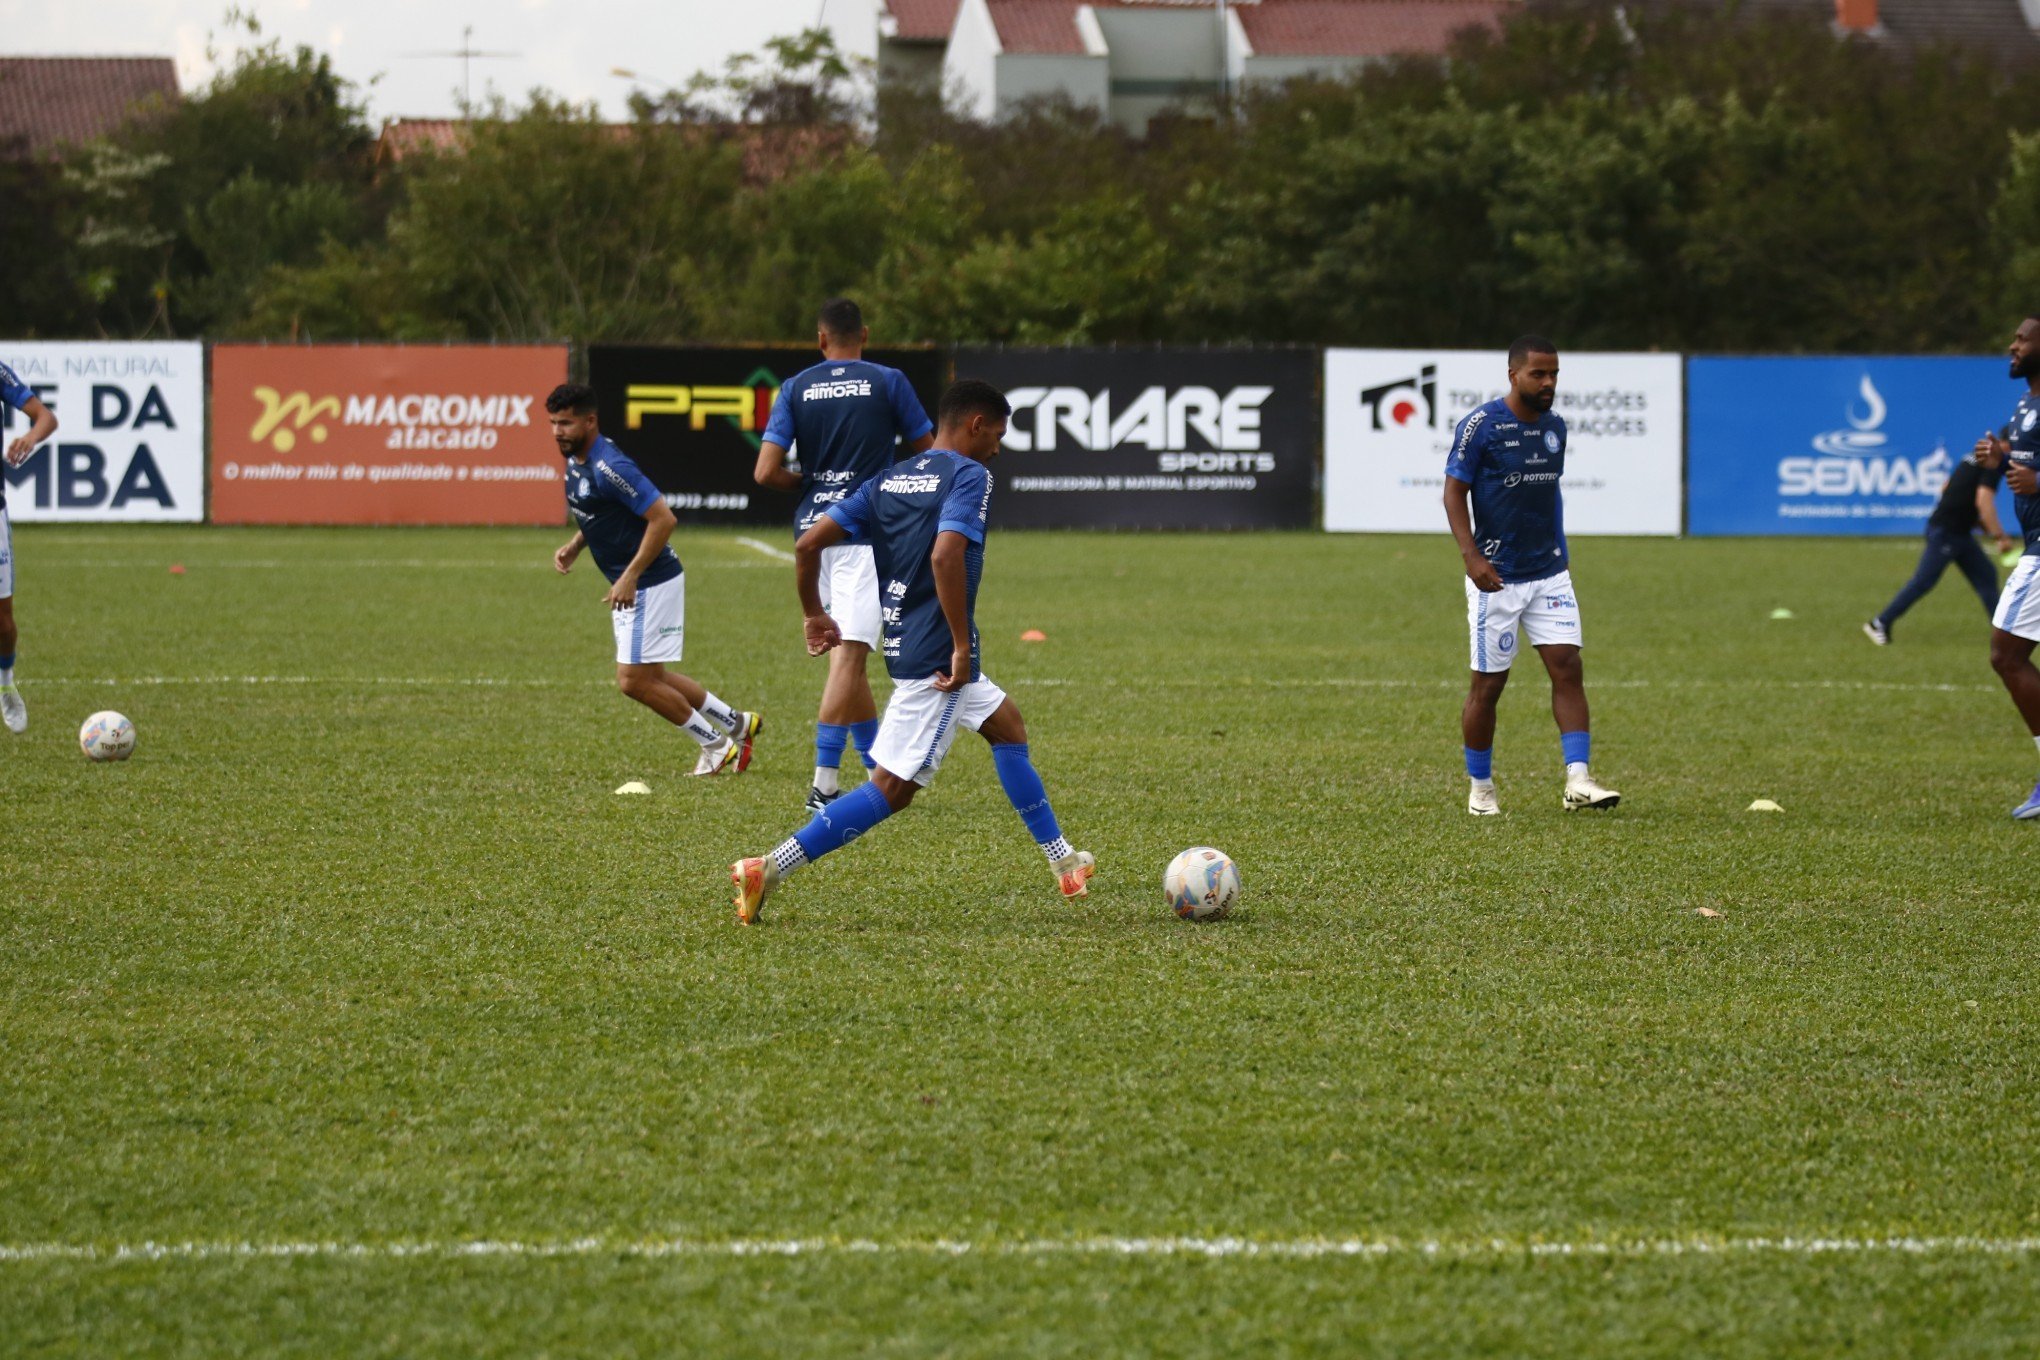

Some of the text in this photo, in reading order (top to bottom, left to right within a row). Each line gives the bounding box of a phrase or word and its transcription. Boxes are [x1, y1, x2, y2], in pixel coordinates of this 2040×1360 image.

[65, 357, 177, 377] NATURAL
[803, 380, 872, 401] AIMORÉ
[91, 384, 177, 430] DA
[344, 394, 534, 426] MACROMIX
[1000, 386, 1274, 450] CRIARE
[386, 427, 498, 449] atacado
[1459, 411, 1487, 452] VINCITORE
[223, 462, 239, 480] O
[243, 461, 303, 480] melhor
[306, 462, 338, 480] mix
[342, 461, 364, 480] de
[368, 461, 453, 485] qualidade
[456, 465, 468, 480] e
[472, 461, 559, 480] economia.
[1159, 453, 1275, 472] SPORTS
[600, 464, 638, 498] VINCITORE
[1107, 476, 1122, 490] DE
[1124, 476, 1183, 490] MATERIAL
[1484, 539, 1501, 555] 27
